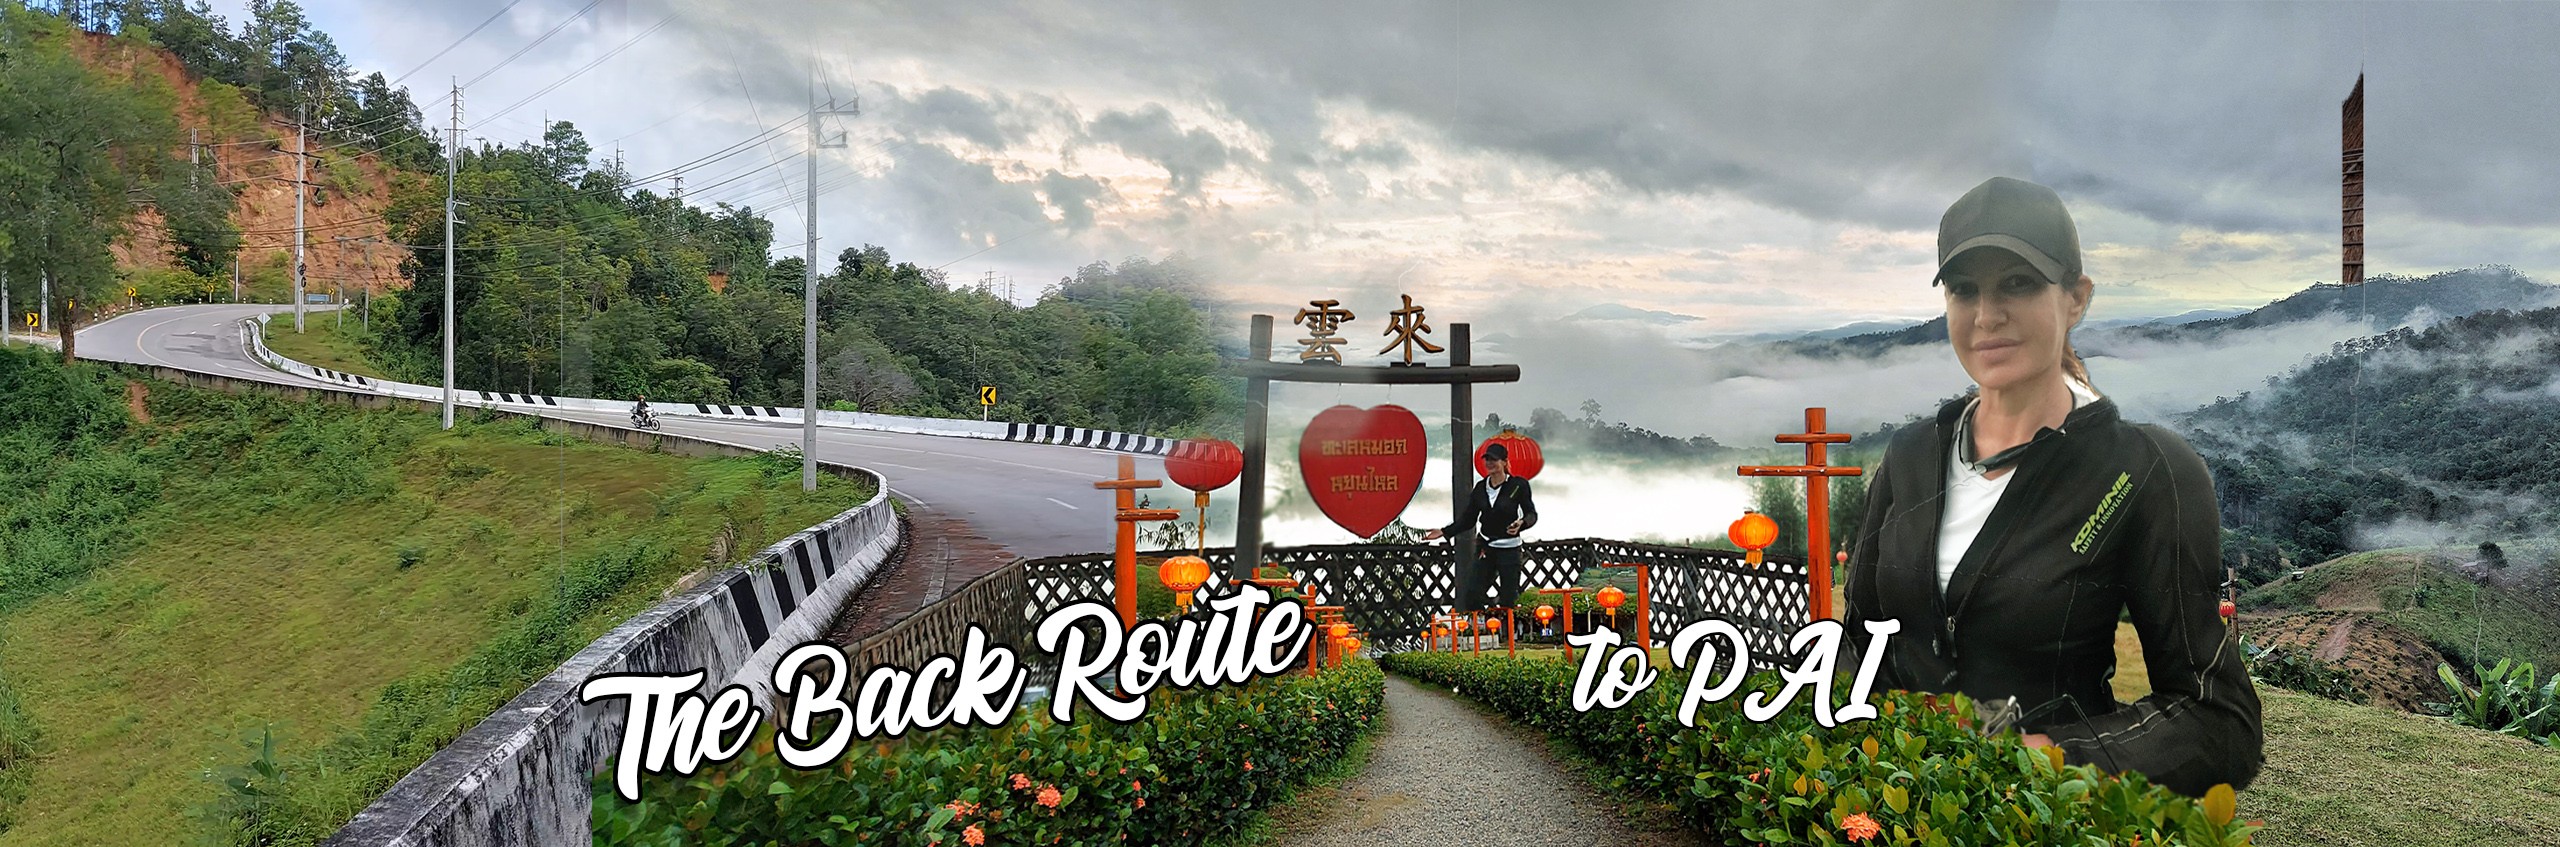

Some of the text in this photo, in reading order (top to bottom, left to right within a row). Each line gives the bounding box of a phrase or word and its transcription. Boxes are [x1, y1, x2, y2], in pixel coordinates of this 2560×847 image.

[1294, 294, 1445, 366] 雲來
[1322, 439, 1407, 456] ทะเลหมอก
[1330, 466, 1398, 499] หยุนไหล
[2071, 472, 2130, 552] KOMINE
[2079, 529, 2099, 555] SAFETY
[2100, 482, 2134, 524] INNOVATION
